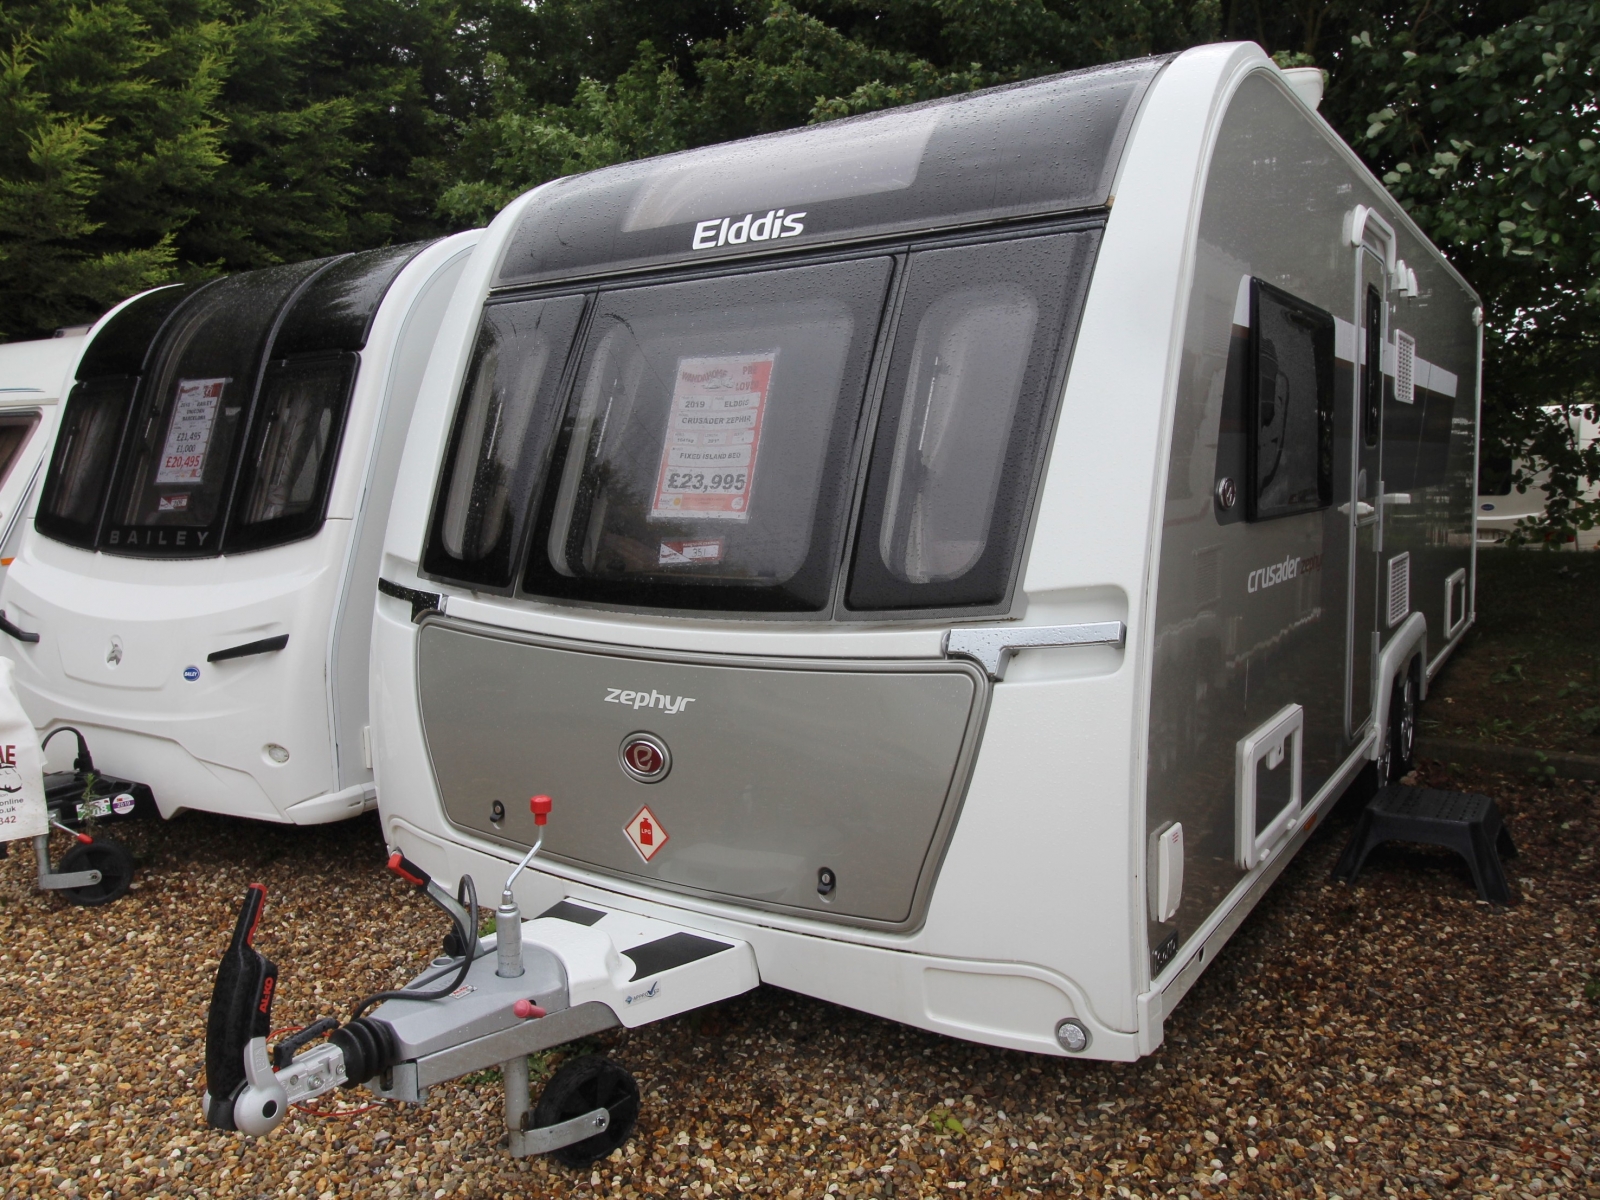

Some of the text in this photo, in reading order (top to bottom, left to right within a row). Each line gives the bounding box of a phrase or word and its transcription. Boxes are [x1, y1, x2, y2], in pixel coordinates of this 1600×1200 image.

[692, 208, 807, 250] Elddis
[724, 399, 750, 408] ELDDIS
[681, 417, 724, 425] CRUSADER
[165, 455, 201, 468] £20,495
[679, 452, 701, 460] FIXED
[668, 473, 746, 493] £23,995
[109, 530, 209, 546] BAILEY
[1247, 555, 1301, 594] crusader
[604, 687, 697, 715] zephyr
